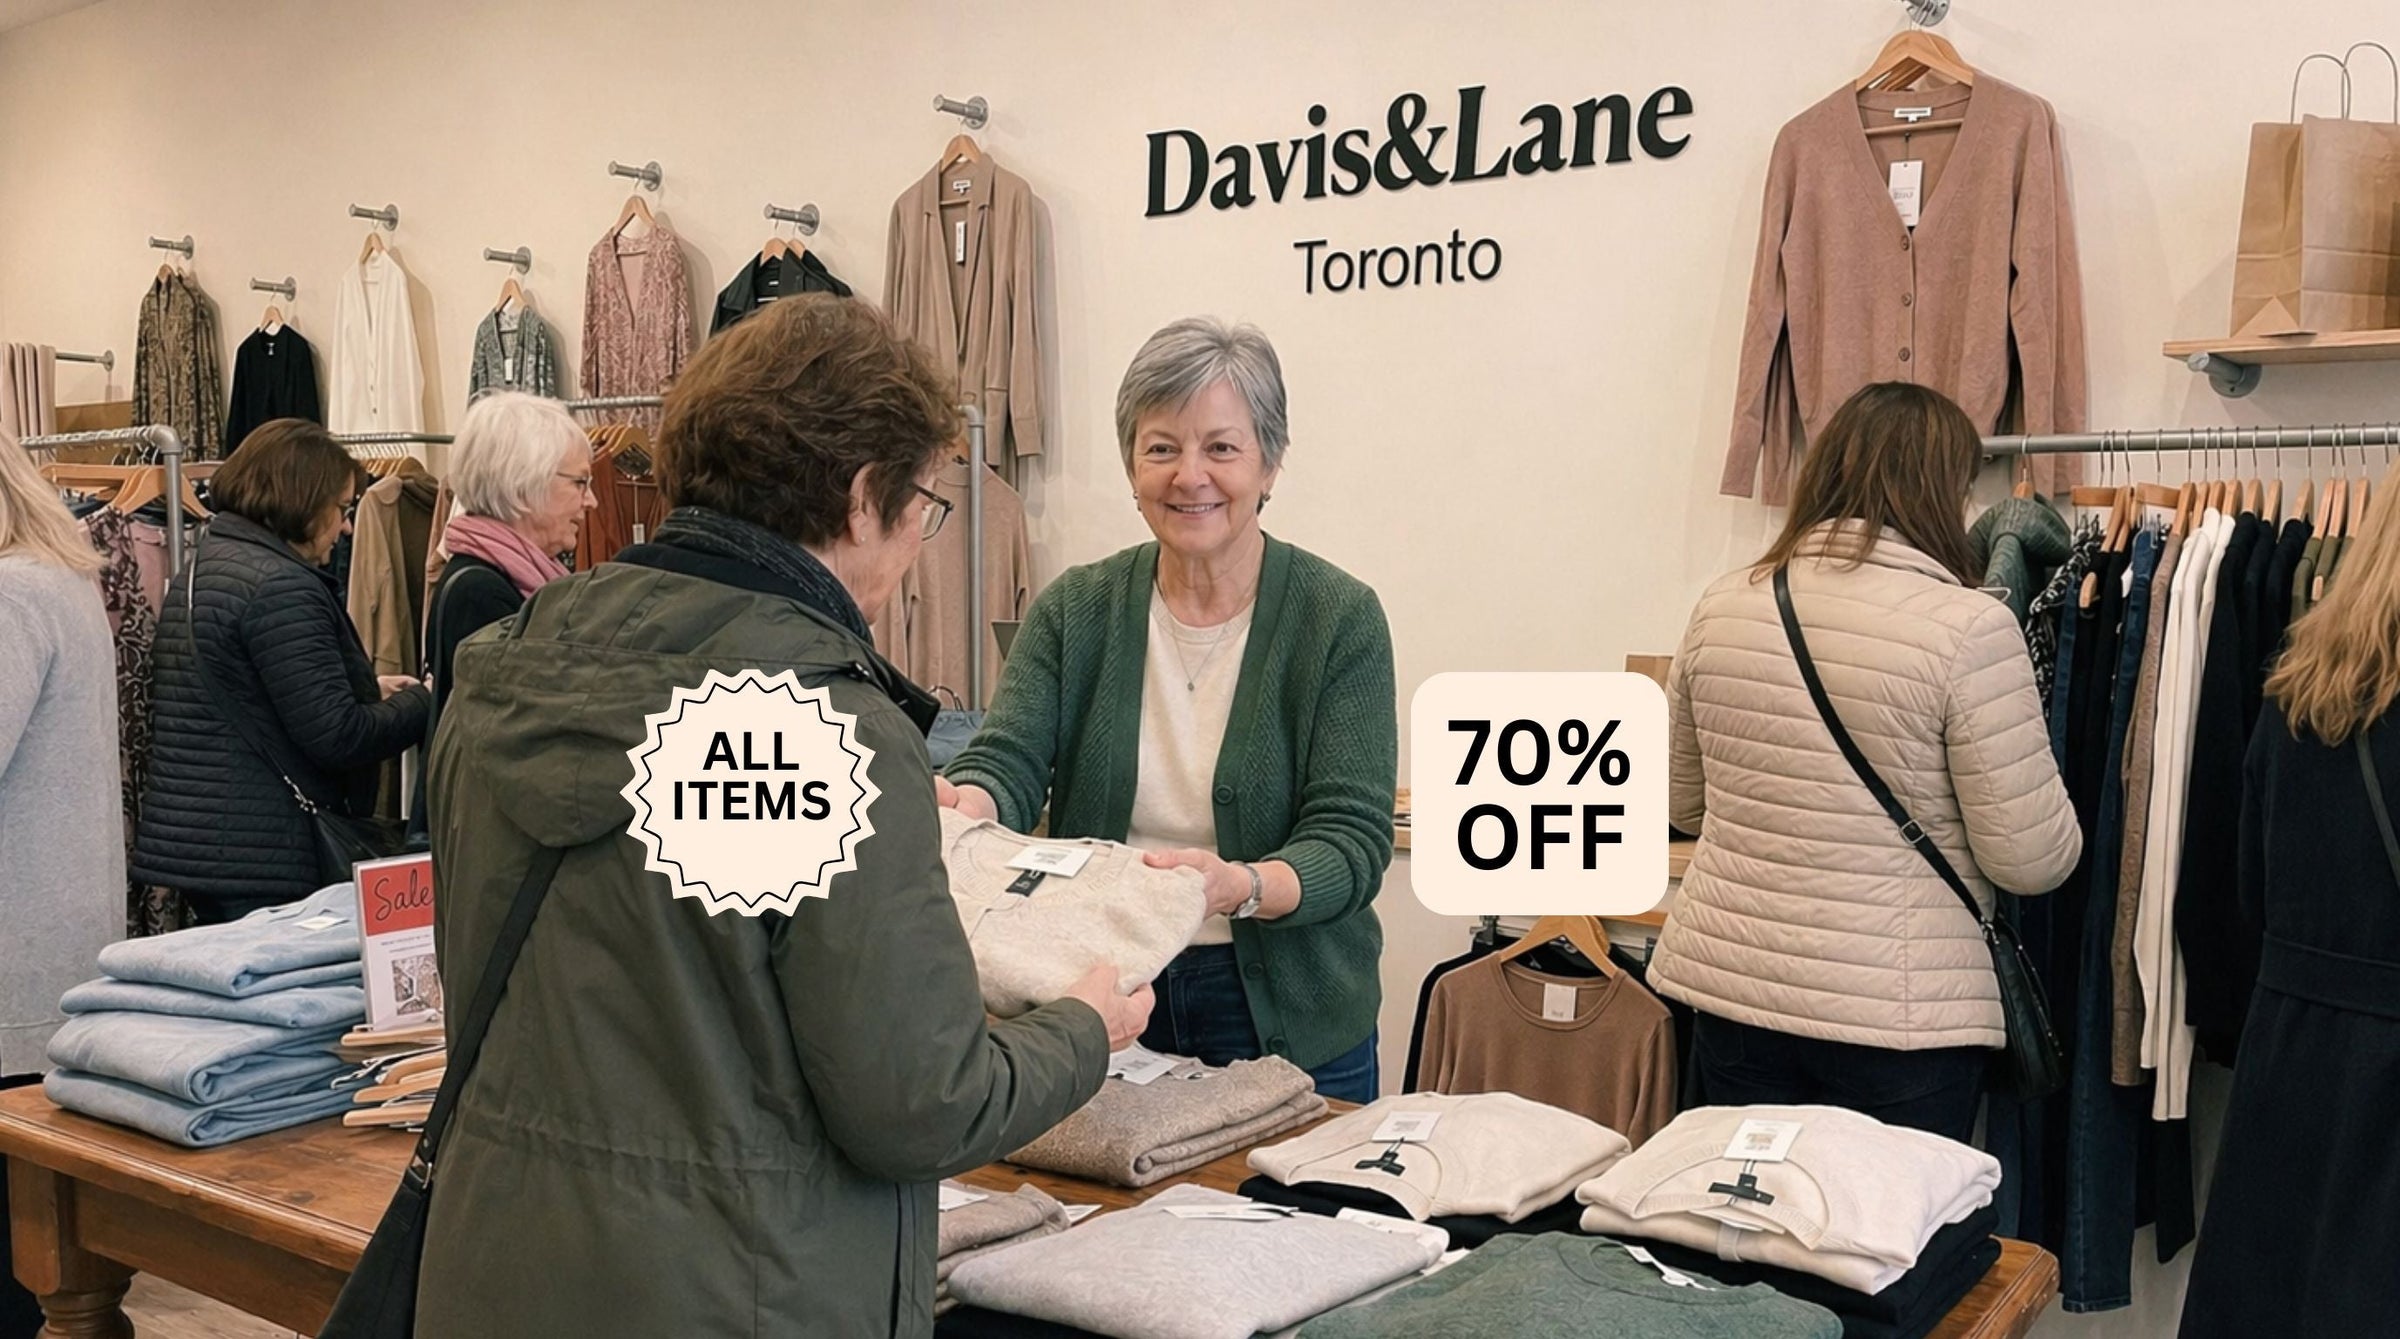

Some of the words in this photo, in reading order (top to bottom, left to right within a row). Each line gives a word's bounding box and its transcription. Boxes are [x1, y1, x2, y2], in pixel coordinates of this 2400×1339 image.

[1144, 85, 1694, 218] Davis&Lane
[1293, 229, 1502, 294] Toronto
[374, 868, 433, 921] Sale
